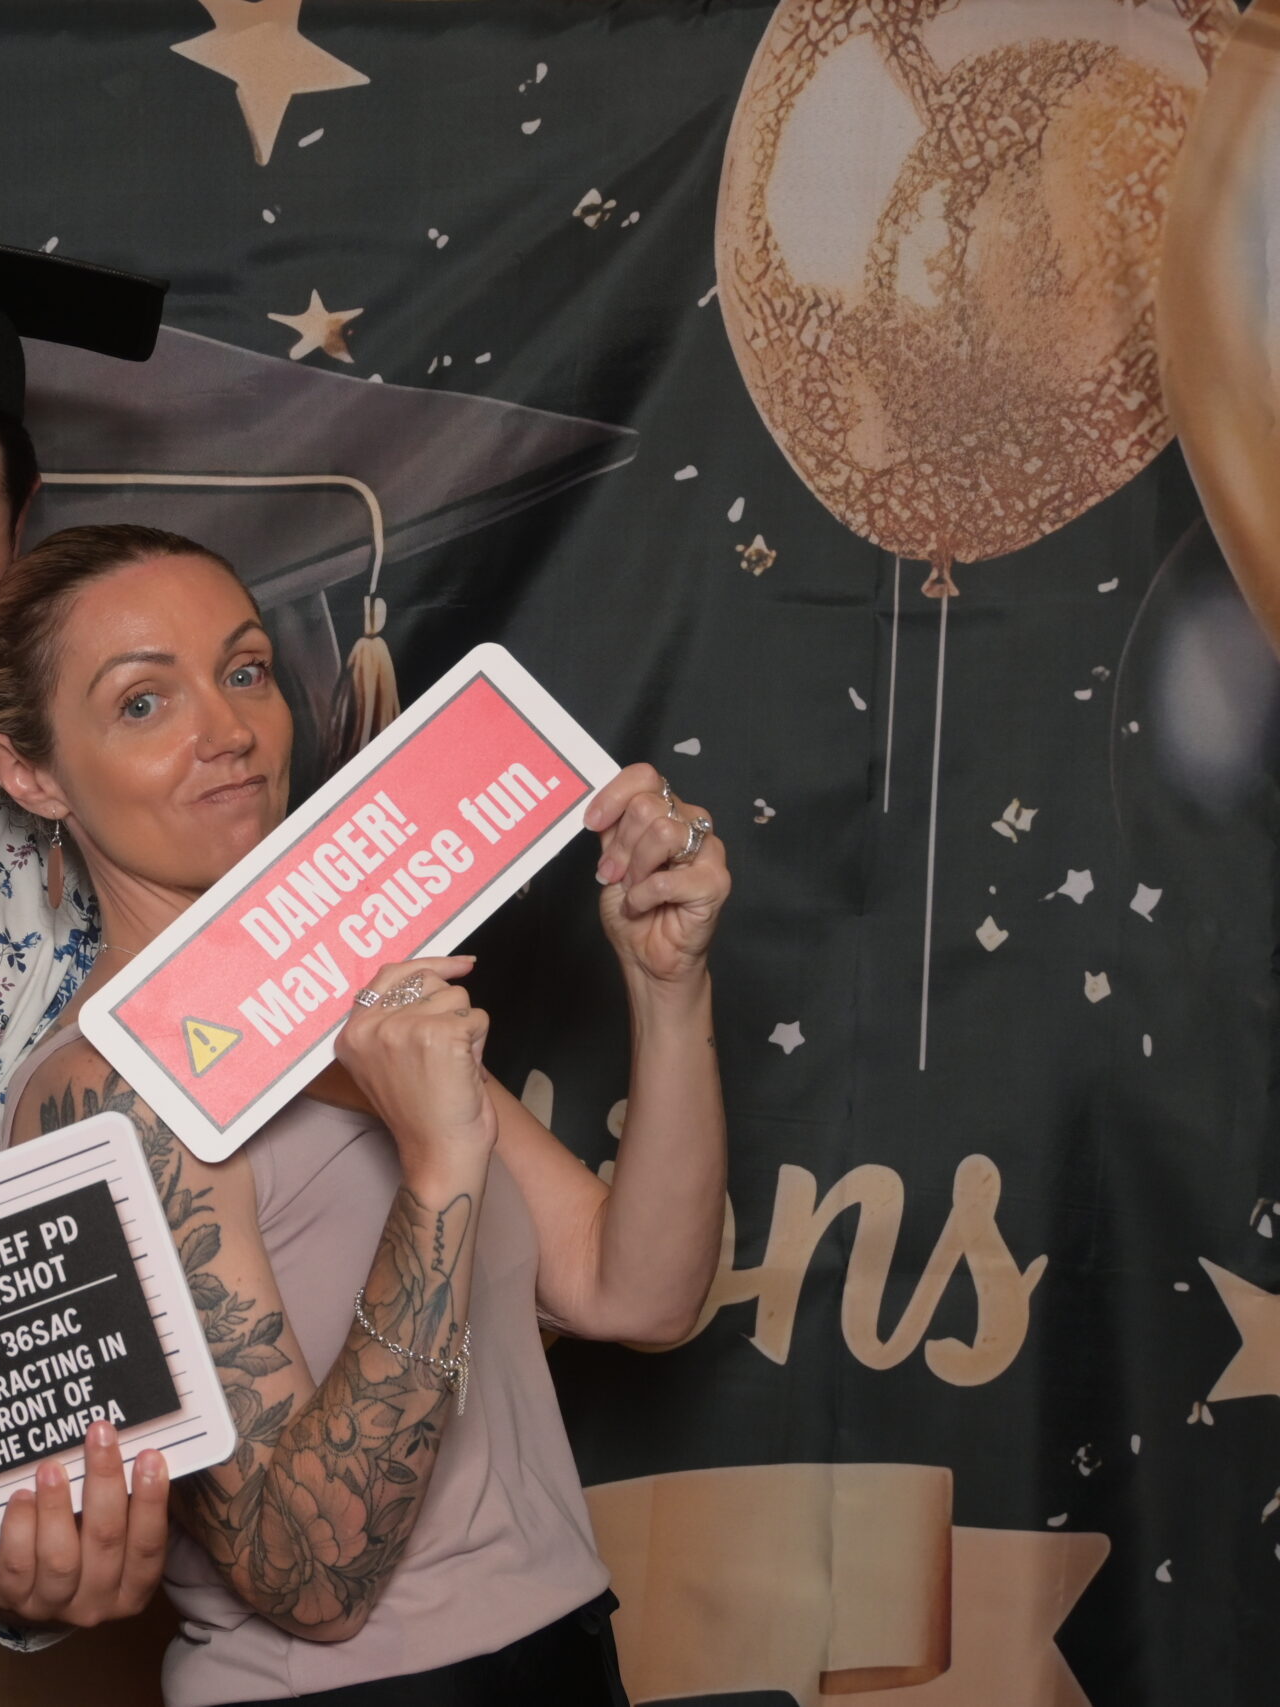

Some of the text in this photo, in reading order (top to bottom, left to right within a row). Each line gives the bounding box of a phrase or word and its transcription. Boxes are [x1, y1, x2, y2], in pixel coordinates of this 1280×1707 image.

[238, 790, 419, 961] DANGER!
[236, 762, 561, 1048] May cause fun.
[39, 1215, 79, 1250] PD
[98, 1331, 127, 1362] IN
[63, 1375, 94, 1407] OF
